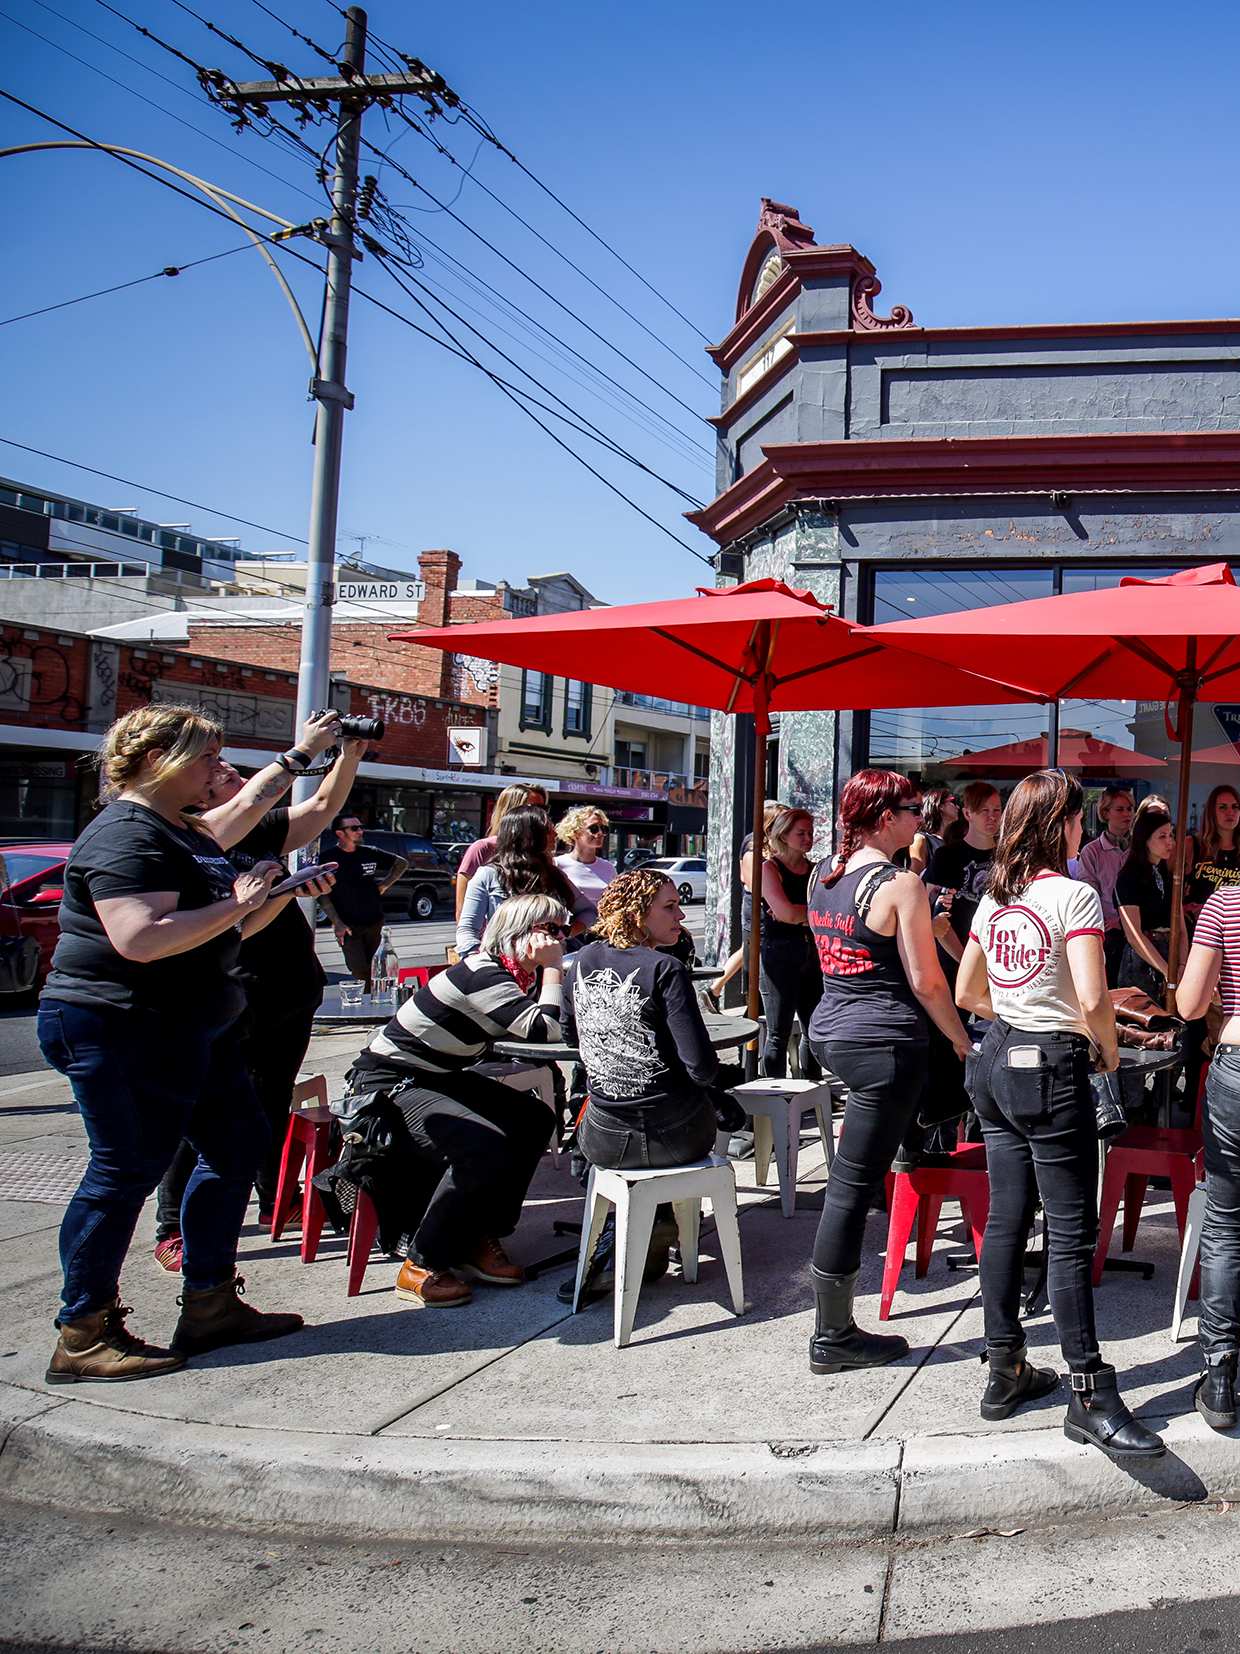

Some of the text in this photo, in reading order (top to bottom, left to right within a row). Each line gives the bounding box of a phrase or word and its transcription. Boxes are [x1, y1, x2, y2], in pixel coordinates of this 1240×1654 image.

[339, 584, 423, 598] EDWARD ST
[995, 943, 1052, 972] Rider
